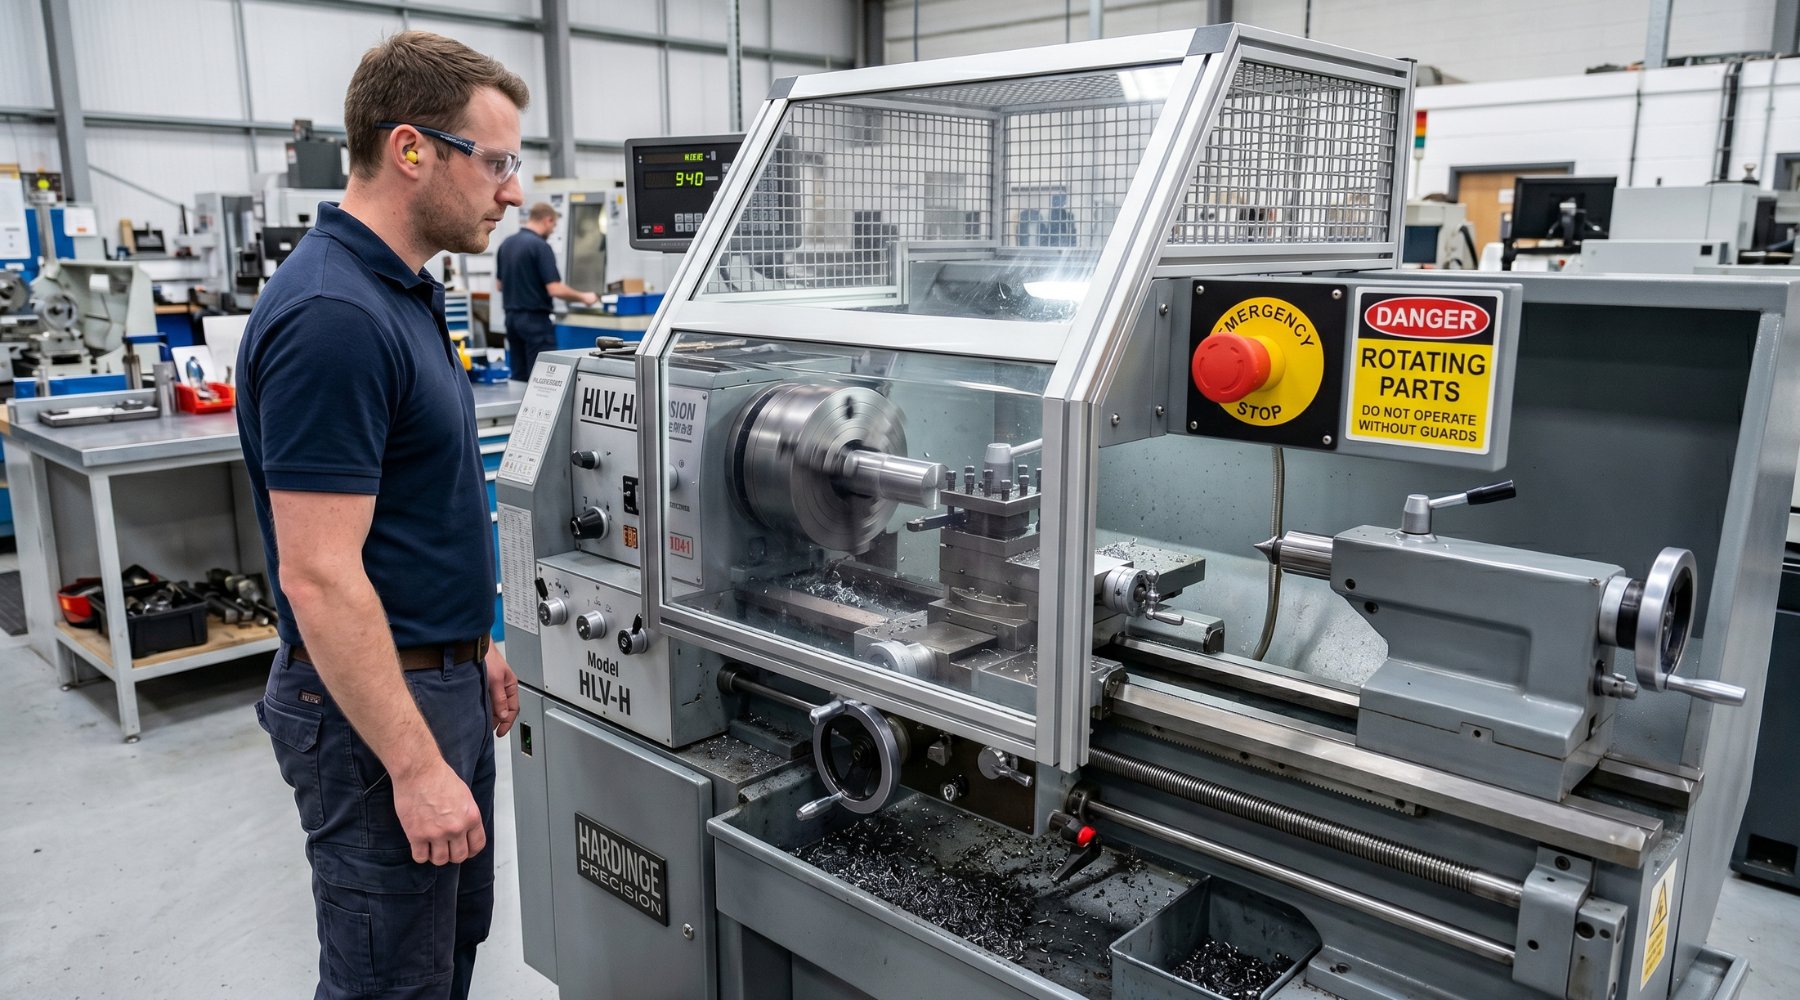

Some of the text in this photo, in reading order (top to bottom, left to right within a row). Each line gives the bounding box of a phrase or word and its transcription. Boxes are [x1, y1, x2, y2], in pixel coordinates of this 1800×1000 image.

[675, 172, 704, 187] 940
[1218, 304, 1315, 346] MERGENCY
[1375, 306, 1477, 331] DANGER
[1361, 348, 1486, 376] ROTATING
[1379, 376, 1460, 402] PARTS
[581, 387, 638, 425] HLV-H
[1236, 401, 1282, 420] STOP
[1361, 405, 1477, 426] DO NOT OPERATE
[1358, 419, 1477, 442] WITHOUT GUARDS
[587, 650, 619, 678] Model
[579, 669, 631, 716] HLV-H
[579, 821, 661, 900] HARDINGE
[580, 858, 661, 916] PRECISION
